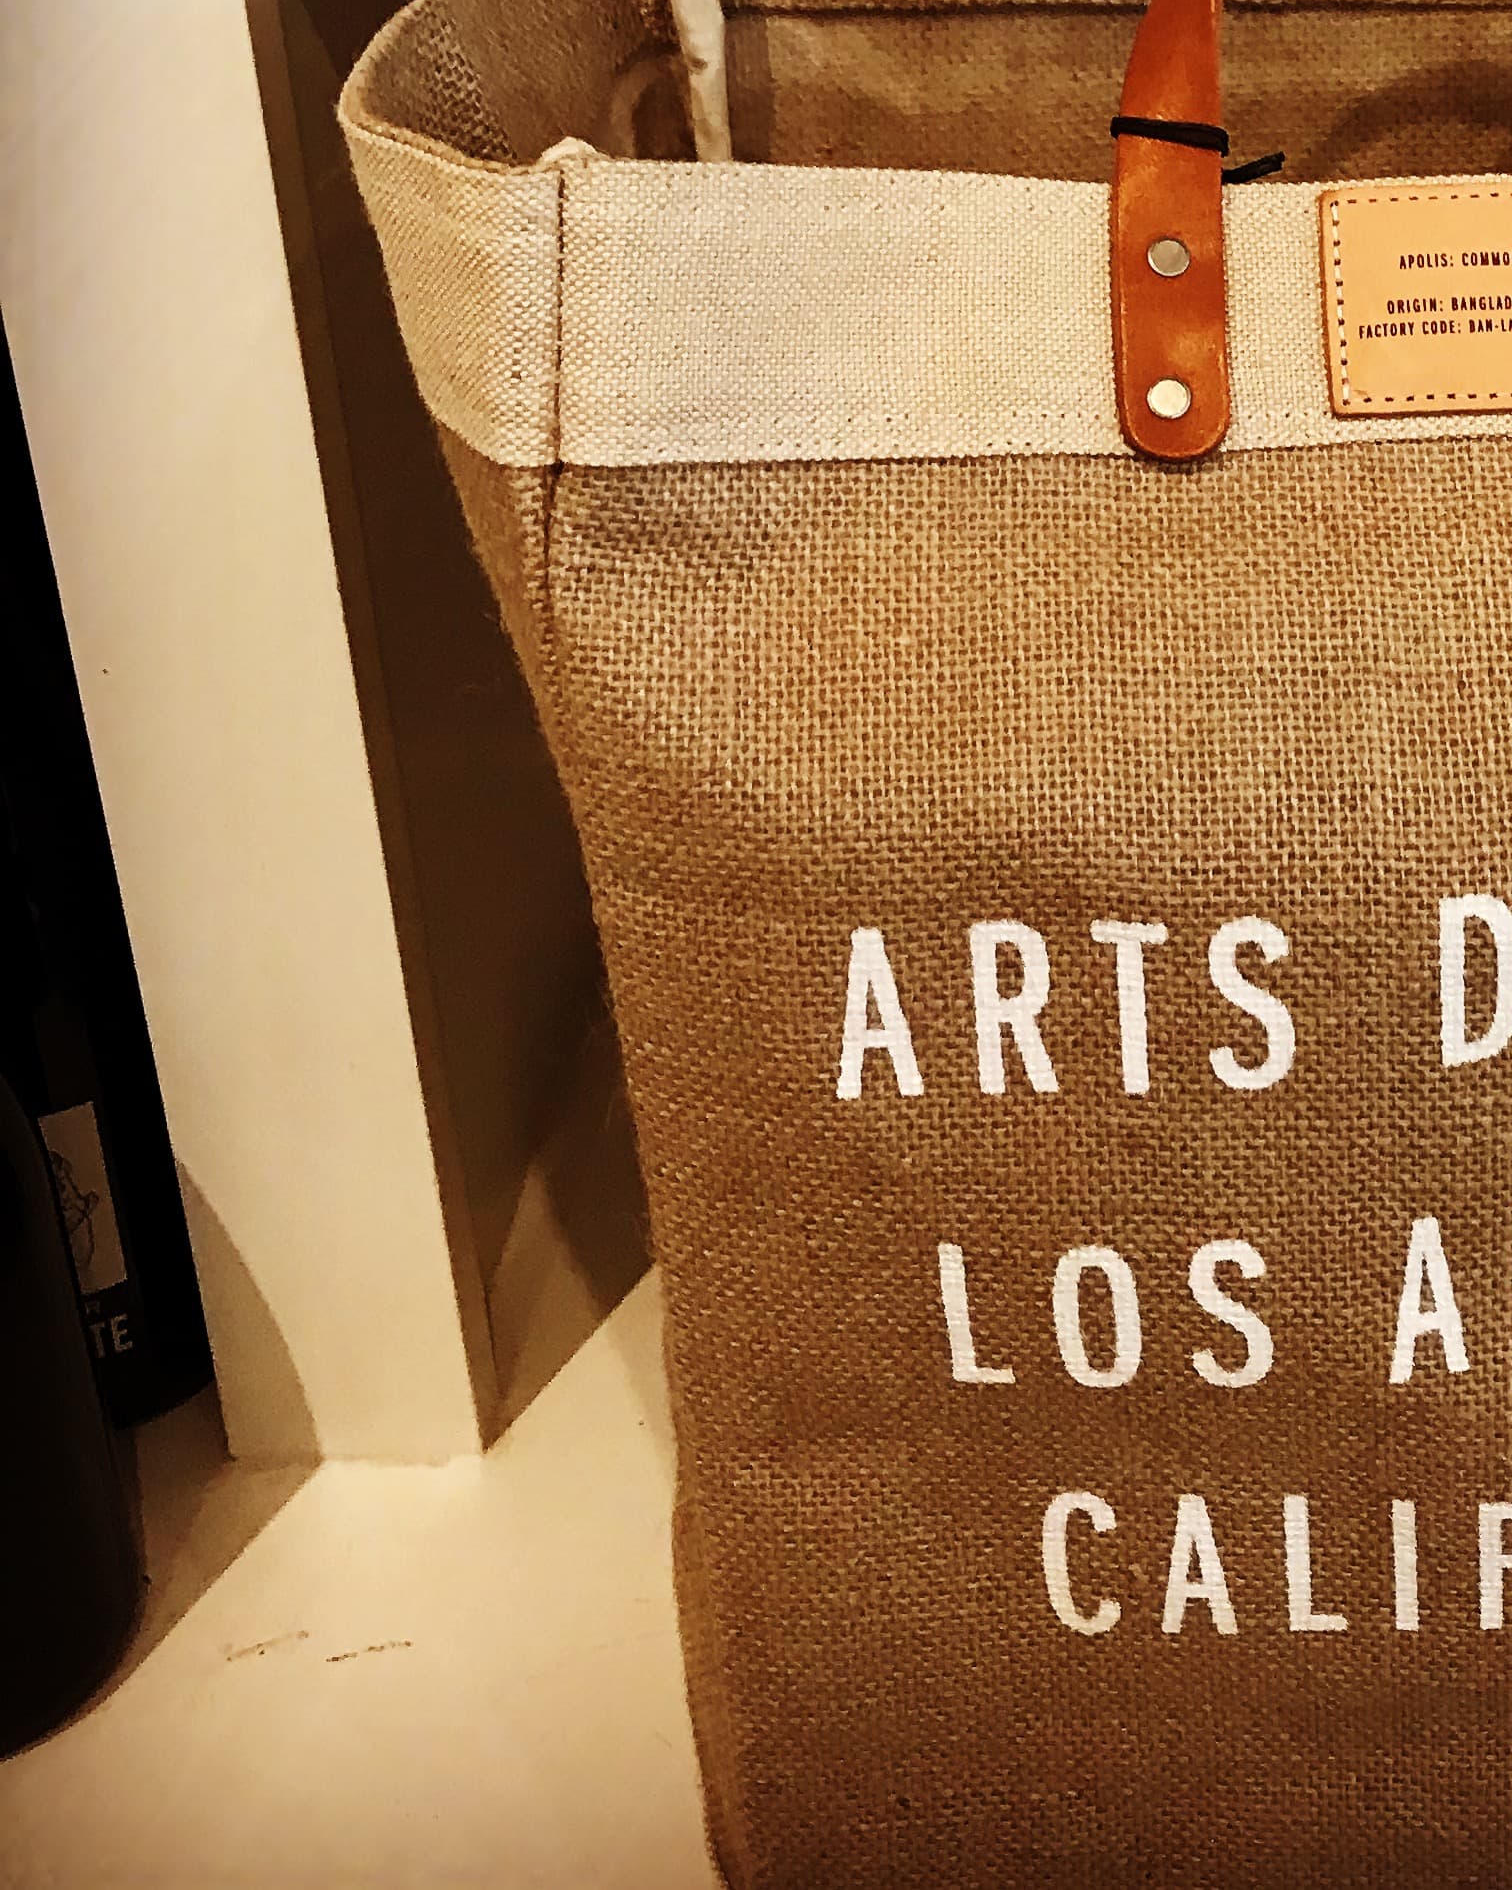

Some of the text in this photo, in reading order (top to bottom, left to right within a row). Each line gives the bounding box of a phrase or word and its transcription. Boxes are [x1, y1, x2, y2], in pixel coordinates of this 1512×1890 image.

[1400, 253, 1454, 270] APOLIS:
[1387, 298, 1444, 315] ORIGIN:
[1359, 321, 1415, 339] FACTORY
[1422, 319, 1462, 335] CODE:
[836, 915, 1297, 1100] ARTS
[938, 1238, 1276, 1390] LOS
